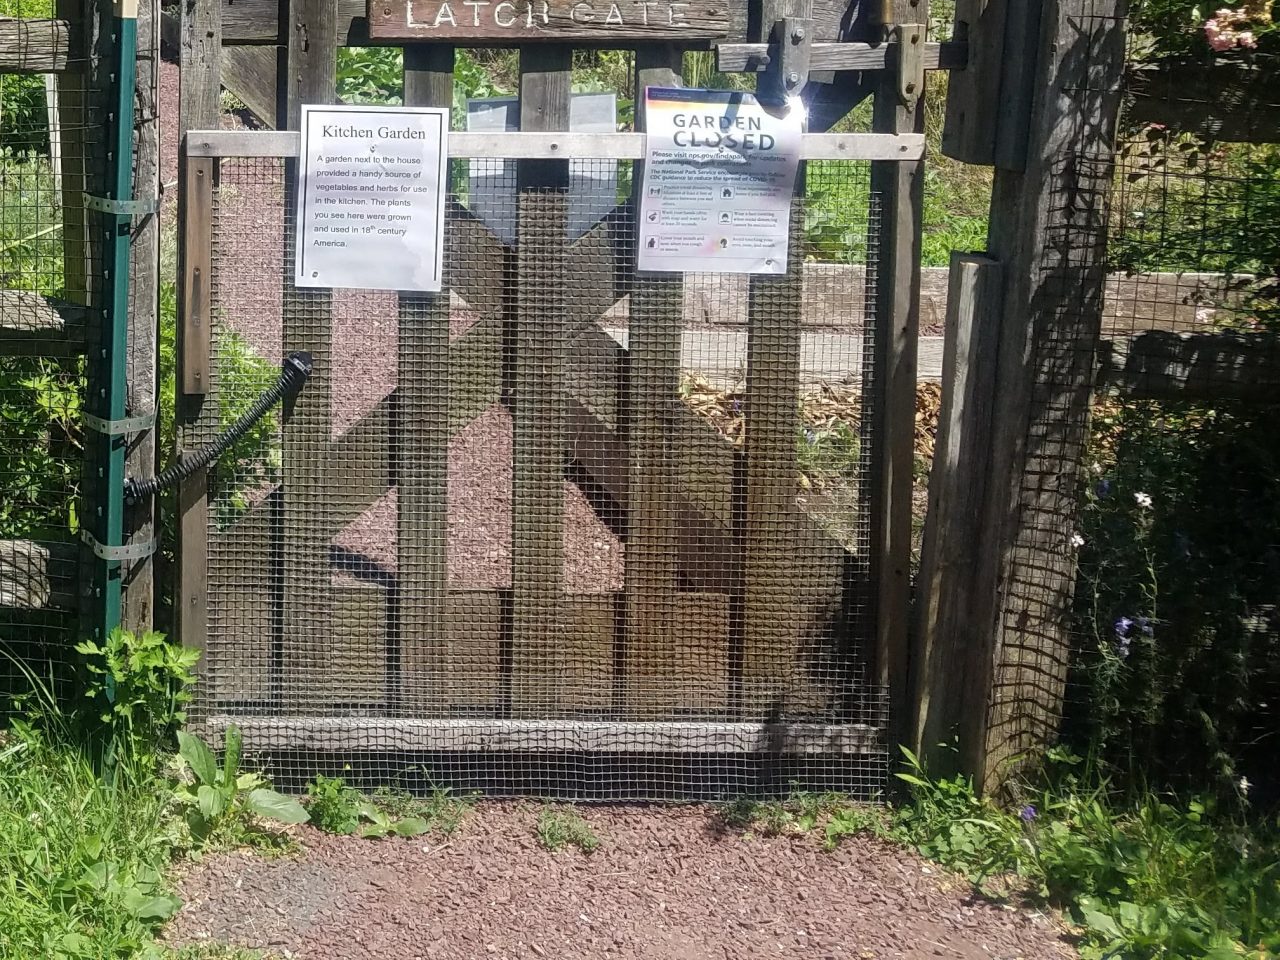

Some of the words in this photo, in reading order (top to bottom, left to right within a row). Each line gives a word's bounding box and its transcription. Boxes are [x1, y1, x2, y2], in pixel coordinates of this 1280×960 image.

[405, 0, 550, 29] LATCH
[569, 0, 692, 27] GATE
[673, 113, 762, 131] GARDEN
[322, 125, 373, 138] Kitchen
[377, 126, 426, 140] Garden
[673, 130, 776, 151] CLOSED
[652, 150, 673, 158] Please
[325, 155, 353, 164] garden
[382, 156, 395, 164] the
[396, 156, 421, 164] house
[316, 169, 350, 177] provided
[359, 169, 383, 179] handy
[315, 183, 358, 192] vegetables
[359, 184, 375, 192] and
[376, 184, 398, 192] herbs
[324, 197, 337, 205] the
[370, 198, 386, 206] The
[387, 199, 412, 207] plants
[314, 212, 329, 220] you
[347, 212, 365, 220] here
[387, 214, 412, 222] grown
[377, 227, 407, 237] century
[313, 239, 348, 248] America.
